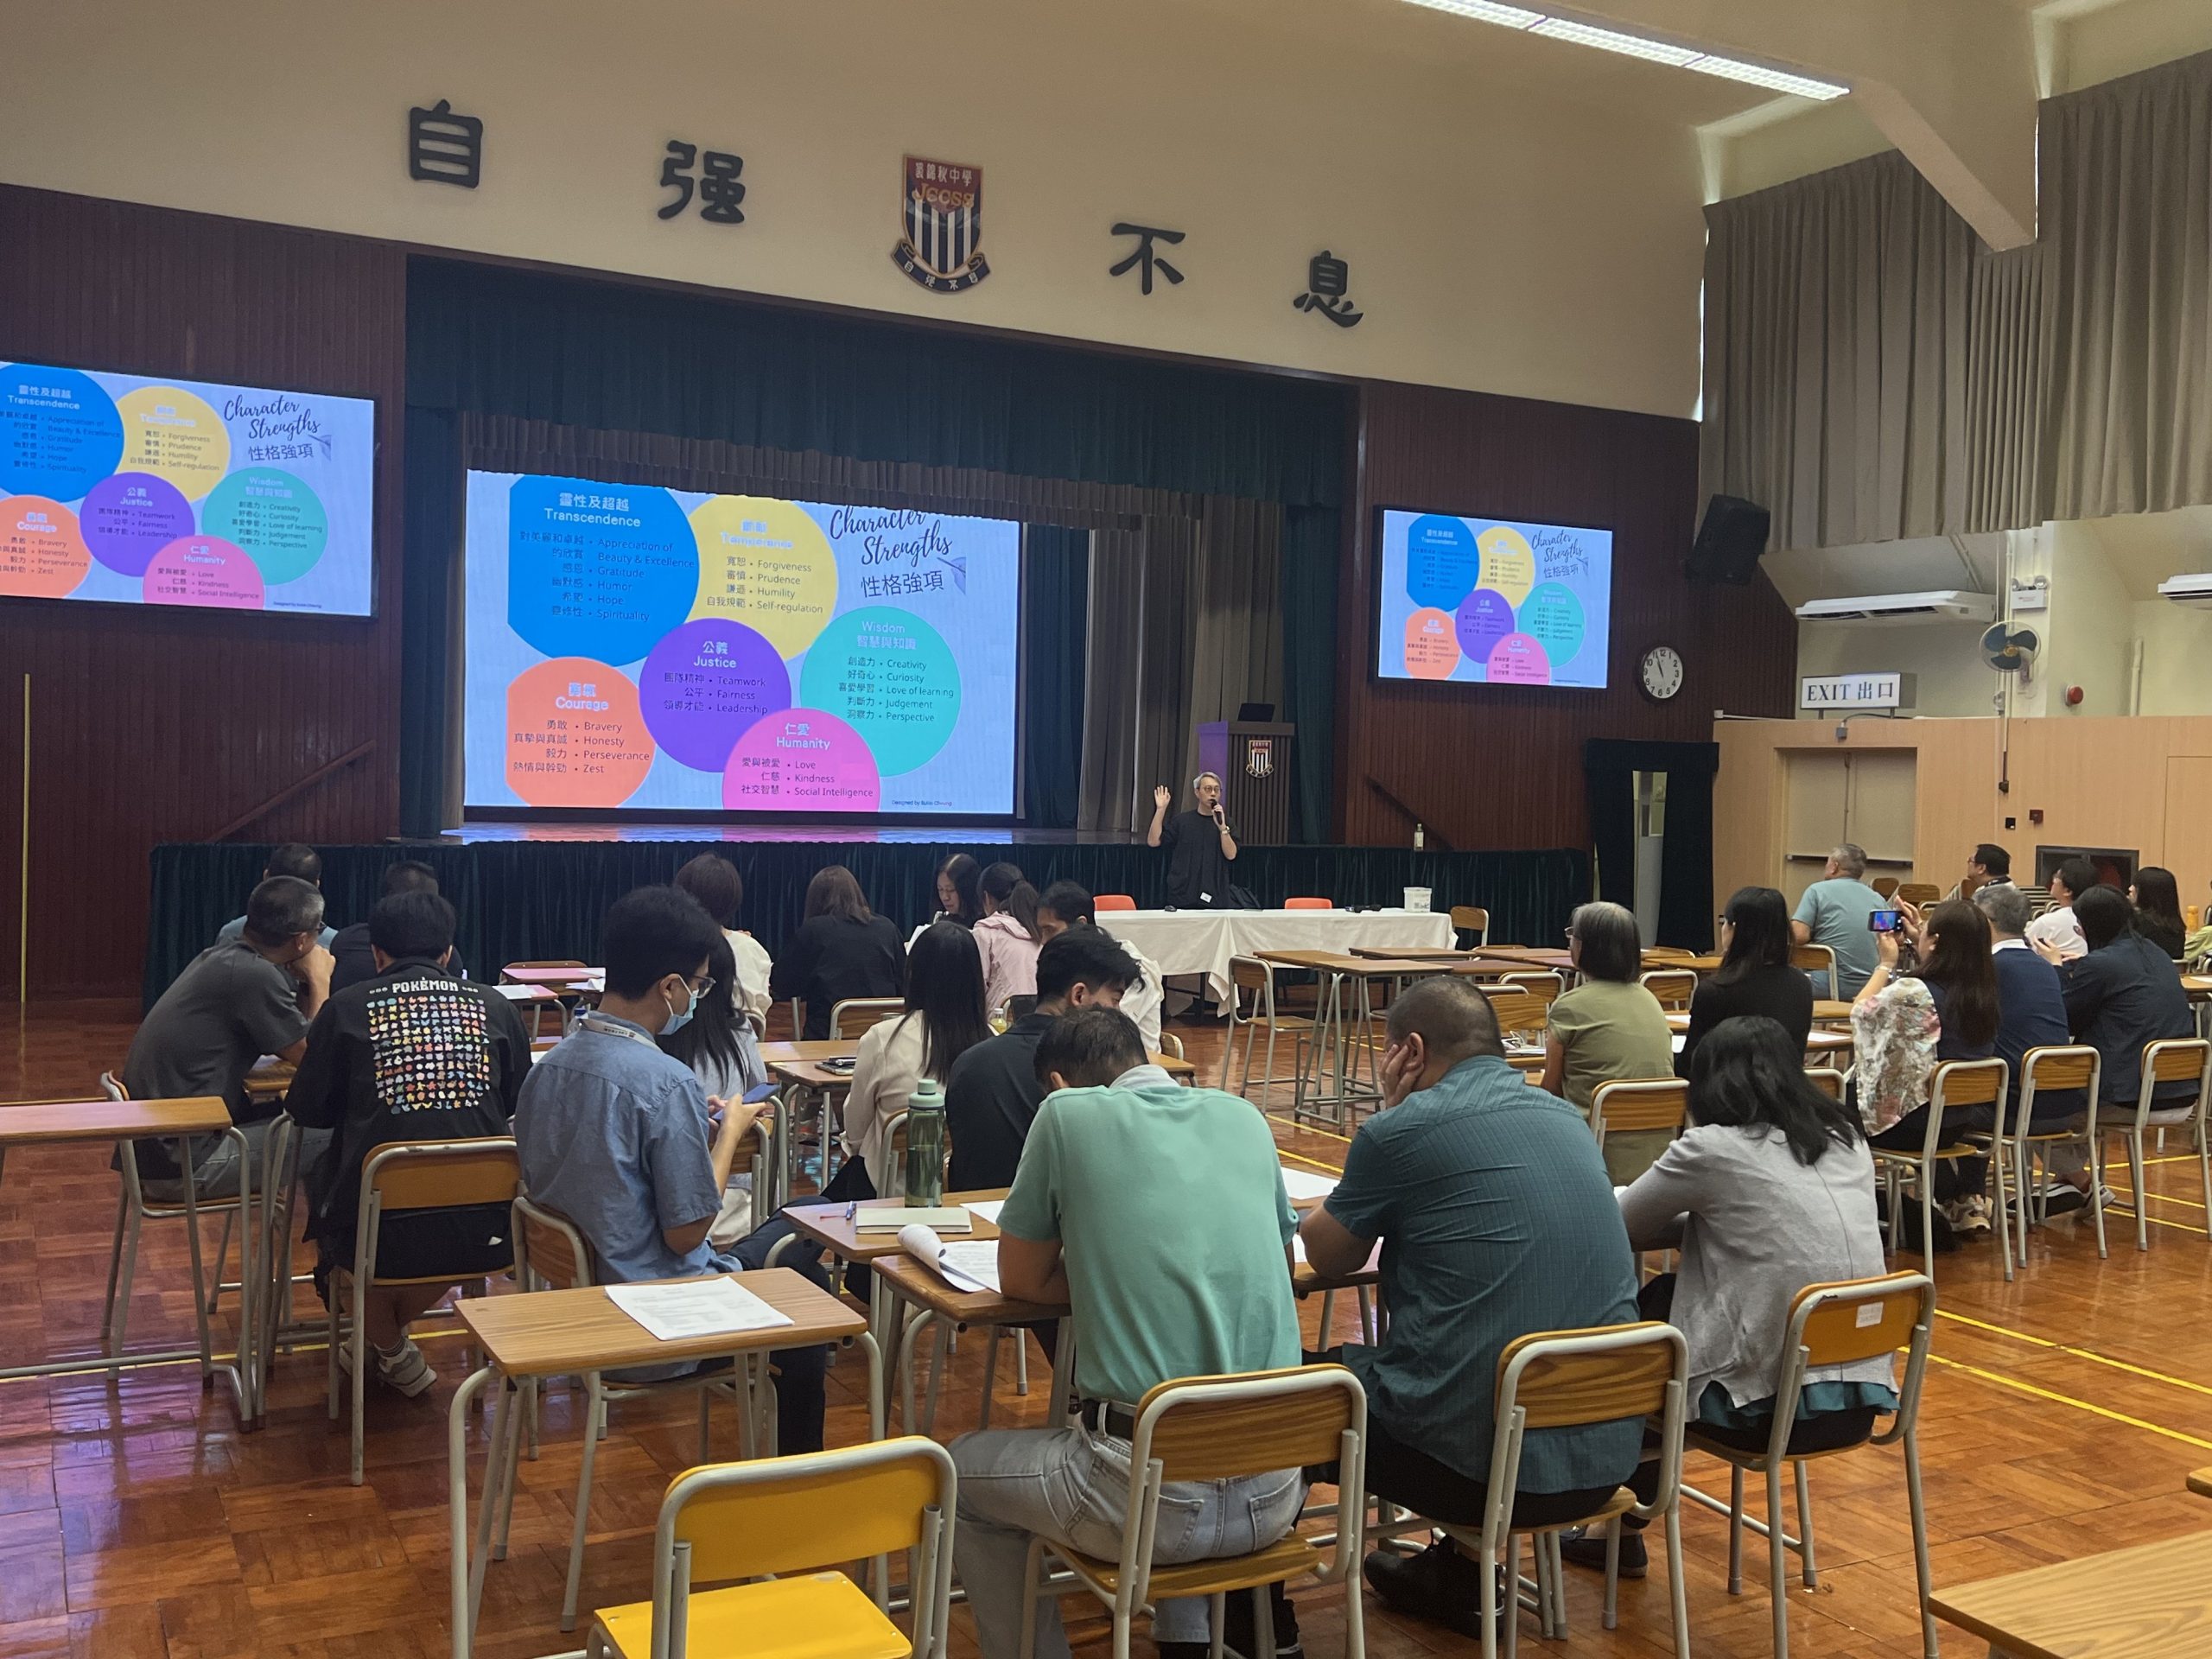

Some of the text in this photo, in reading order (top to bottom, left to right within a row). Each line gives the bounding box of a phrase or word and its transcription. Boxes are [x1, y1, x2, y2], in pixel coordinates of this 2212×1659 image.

[7, 395, 80, 410] Transcendence
[224, 394, 300, 421] Character
[249, 408, 321, 441] Strengths
[168, 432, 210, 442] Forgiveness
[168, 442, 201, 451] Prudence
[249, 443, 315, 461] 性格強項
[249, 476, 283, 486] Wisdom
[120, 497, 153, 507] Justice
[269, 503, 301, 513] Creativity
[559, 493, 629, 512] 靈性及超越
[138, 512, 175, 520] Teamwork
[269, 512, 299, 522] Curiosity
[544, 507, 641, 527] Transcendence
[295, 524, 322, 533] learning
[830, 505, 927, 540] Character
[138, 531, 178, 539] Leadership
[1532, 530, 1571, 550] Character
[38, 538, 67, 548] Bravery
[598, 537, 659, 553] Appreciation
[663, 543, 673, 552] of
[861, 519, 953, 567] Strengths
[38, 549, 69, 557] Honesty
[1544, 538, 1583, 563] Strengths
[38, 558, 88, 568] Perseverance
[183, 554, 226, 566] Humanity
[598, 552, 632, 565] Beauty
[645, 556, 695, 568] Excellence
[758, 559, 812, 572] Forgiveness
[598, 567, 645, 578] Gratitude
[758, 574, 801, 585] Prudence
[861, 570, 944, 598] 性格強項
[598, 582, 632, 591] Humor
[219, 590, 259, 599] Intelligence
[598, 594, 624, 606] Hope
[758, 588, 796, 601] Humility
[757, 601, 823, 613] Self-regulation
[597, 609, 650, 622] Spirituality
[862, 620, 905, 633] Wisdom
[694, 656, 736, 668] Justice
[887, 659, 927, 671] Creativity
[717, 677, 766, 687] Teamwork
[887, 673, 925, 684] Curiosity
[684, 688, 755, 700] 公平 Fairness
[887, 687, 907, 696] Love
[909, 687, 918, 696] of
[919, 687, 954, 698] learning
[1807, 681, 1893, 701] EXIT 出口
[556, 696, 608, 711] Courage
[716, 704, 768, 715] Leadership
[886, 700, 932, 711] Judgement
[886, 712, 935, 724] Perspective
[584, 721, 622, 734] Bravery
[584, 735, 625, 747] Honesty
[777, 737, 831, 751] Humanity
[584, 750, 650, 761] Perseverance
[584, 764, 604, 773] Zest
[795, 760, 816, 770] Love
[795, 774, 835, 784] Kindness
[741, 784, 873, 799] 社交智慧 Social Intelligence
